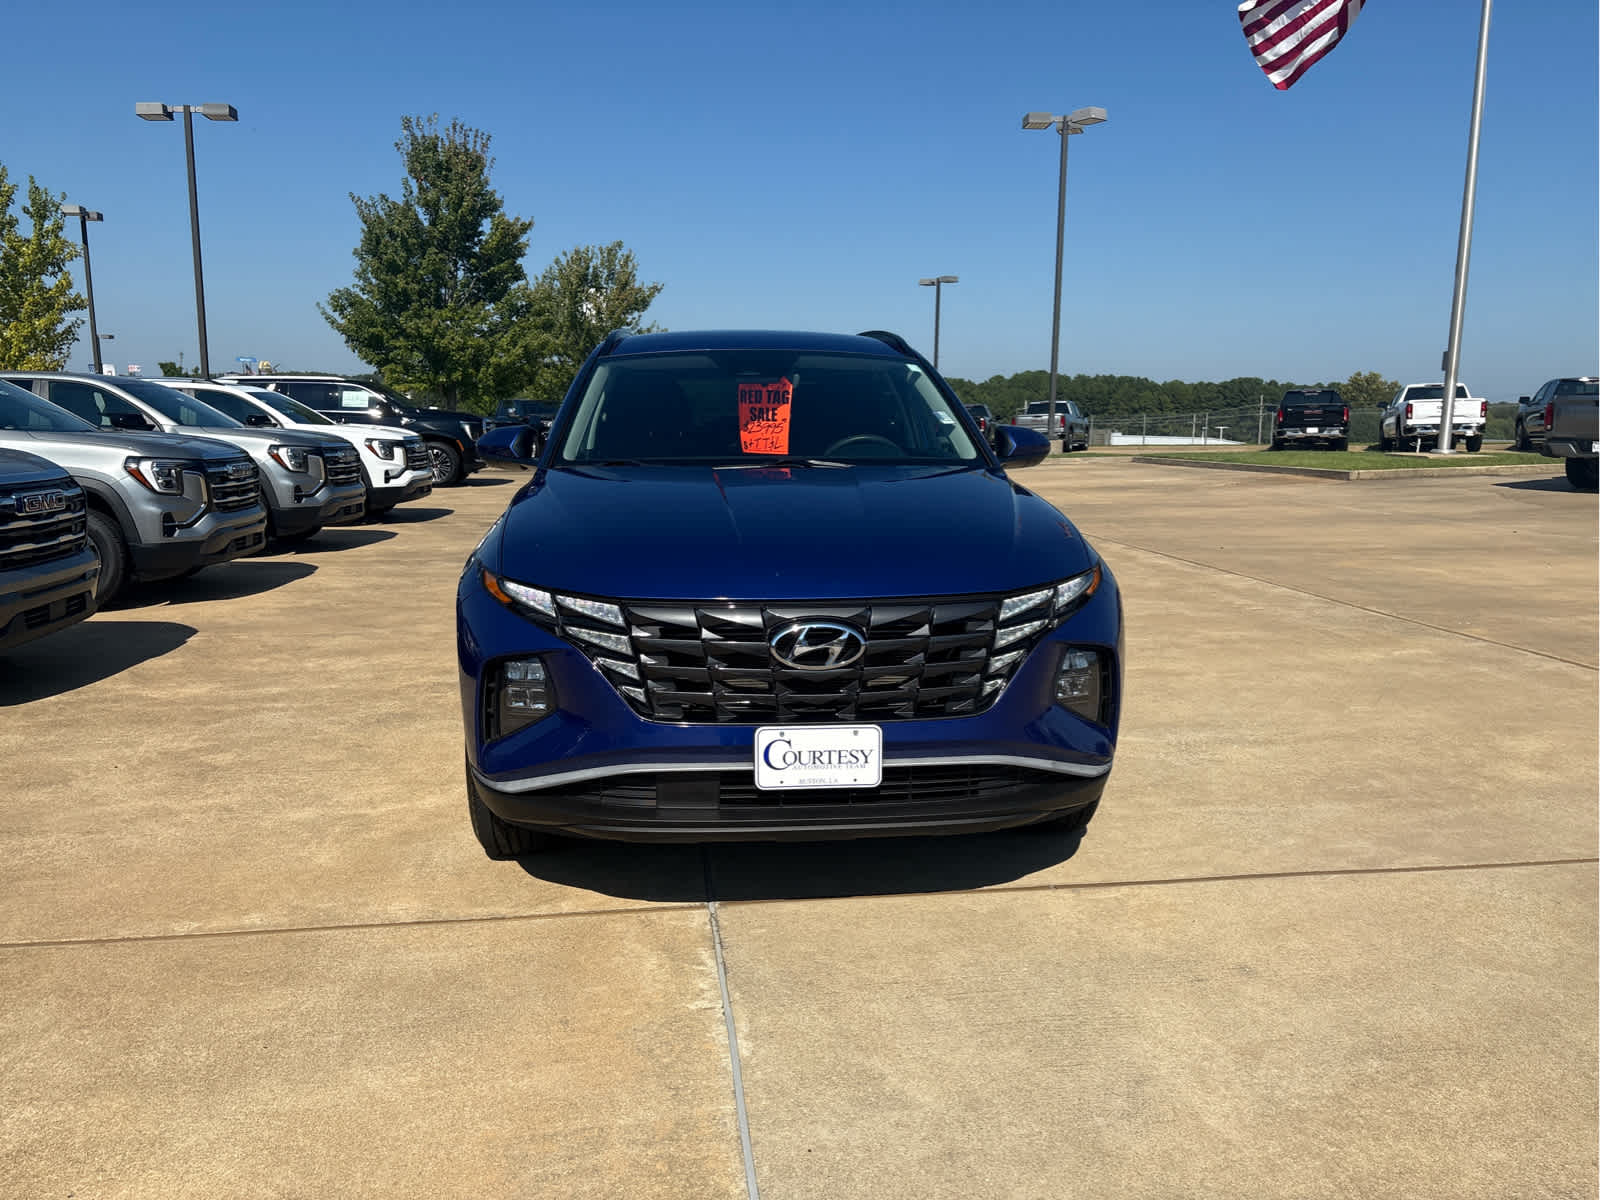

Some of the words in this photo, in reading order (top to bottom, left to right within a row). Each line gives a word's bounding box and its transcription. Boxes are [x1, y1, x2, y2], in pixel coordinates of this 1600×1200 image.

[740, 390, 762, 404] RED
[766, 390, 790, 404] TAG
[750, 407, 778, 422] SALE
[25, 493, 66, 512] GMC
[763, 739, 873, 771] COURTESY
